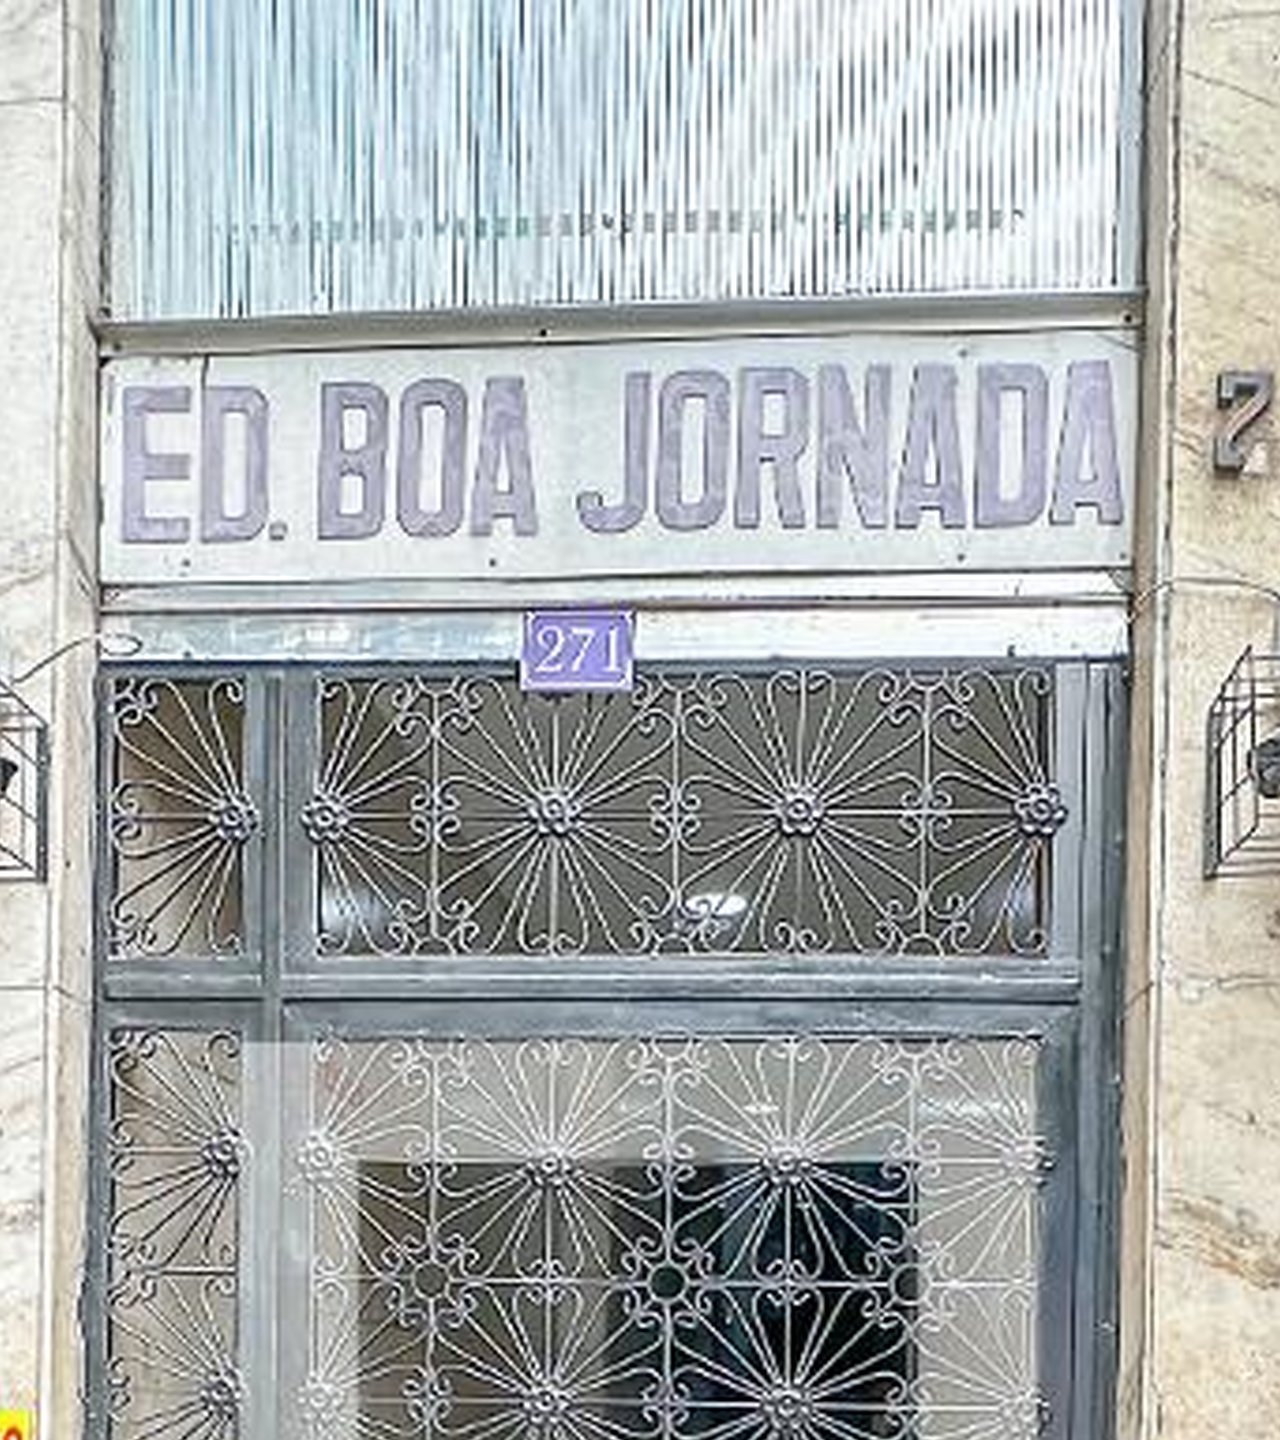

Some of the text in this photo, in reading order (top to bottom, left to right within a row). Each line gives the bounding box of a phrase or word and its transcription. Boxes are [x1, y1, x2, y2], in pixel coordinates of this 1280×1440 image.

[121, 360, 1123, 543] ED. BOA JORNADA
[534, 626, 621, 674] 271
